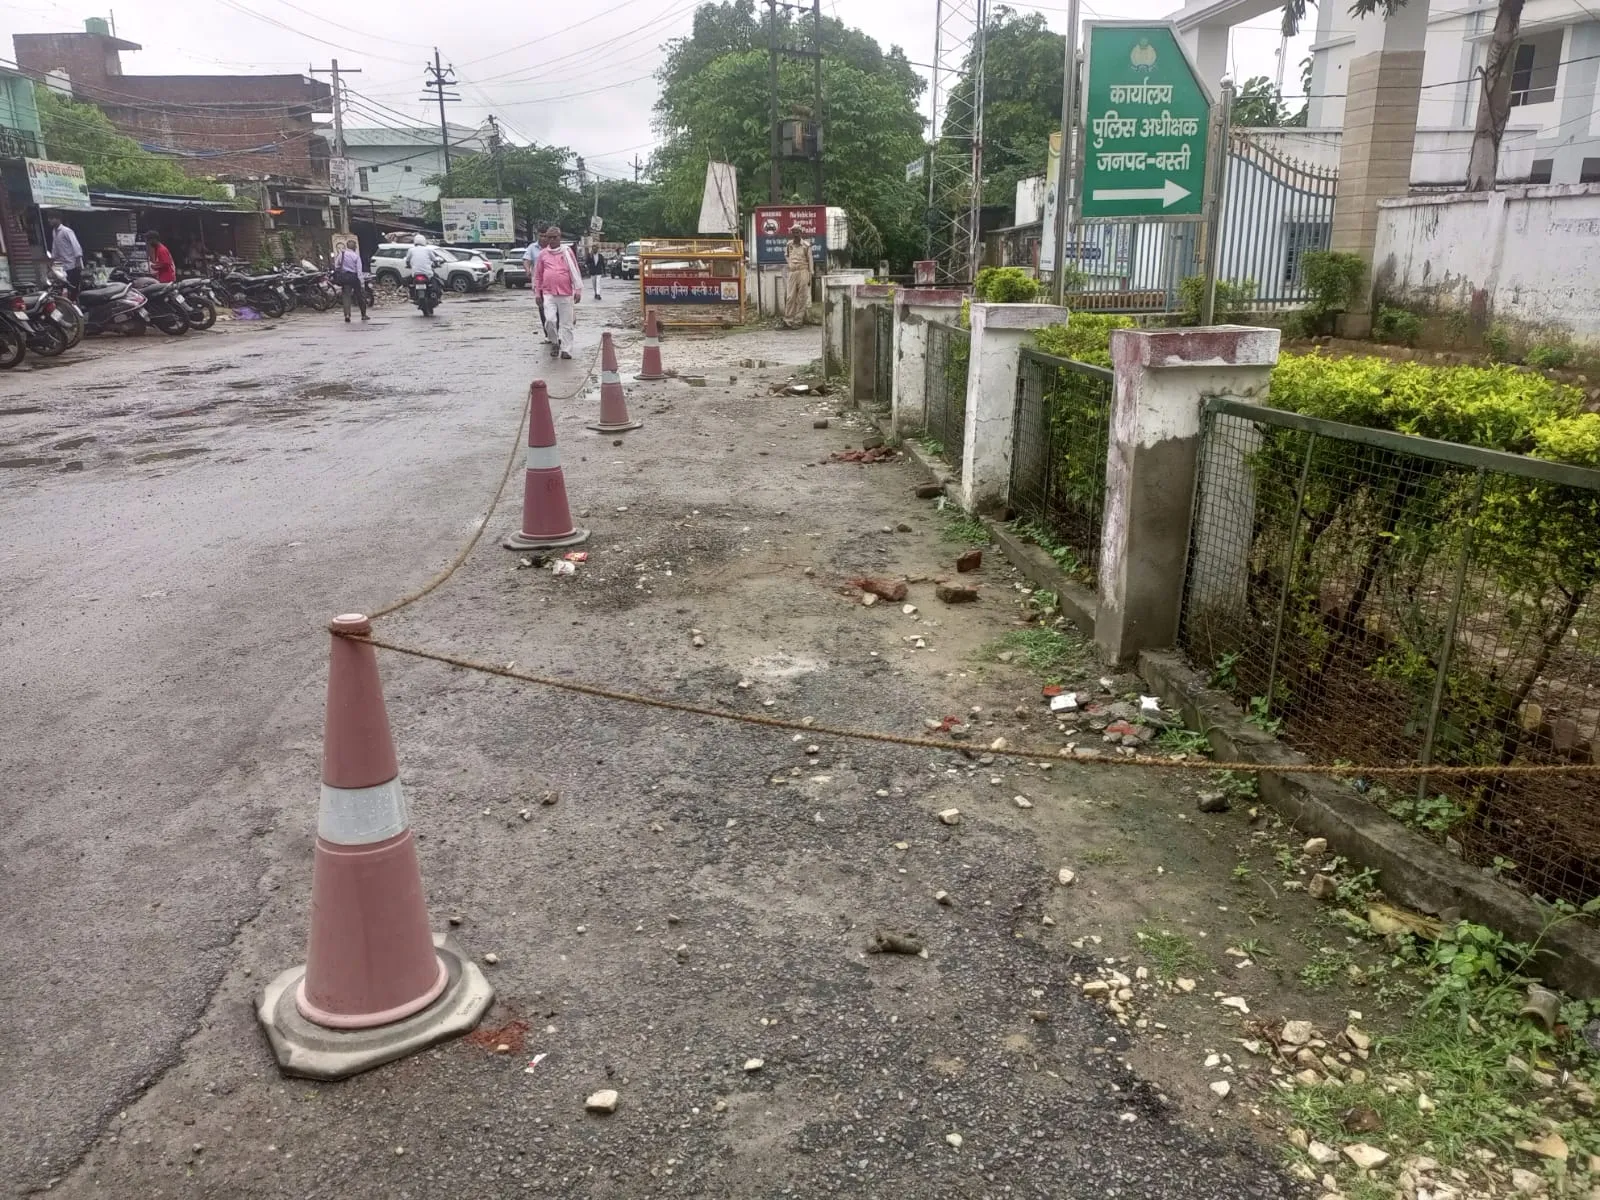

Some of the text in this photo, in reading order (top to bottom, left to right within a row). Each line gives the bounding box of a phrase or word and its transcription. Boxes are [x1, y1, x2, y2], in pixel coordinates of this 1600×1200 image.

[1110, 76, 1173, 105] कार्यालय
[1092, 110, 1199, 149] पुलिस अधीक्षक
[1096, 144, 1191, 172] जनपद-बस्ती
